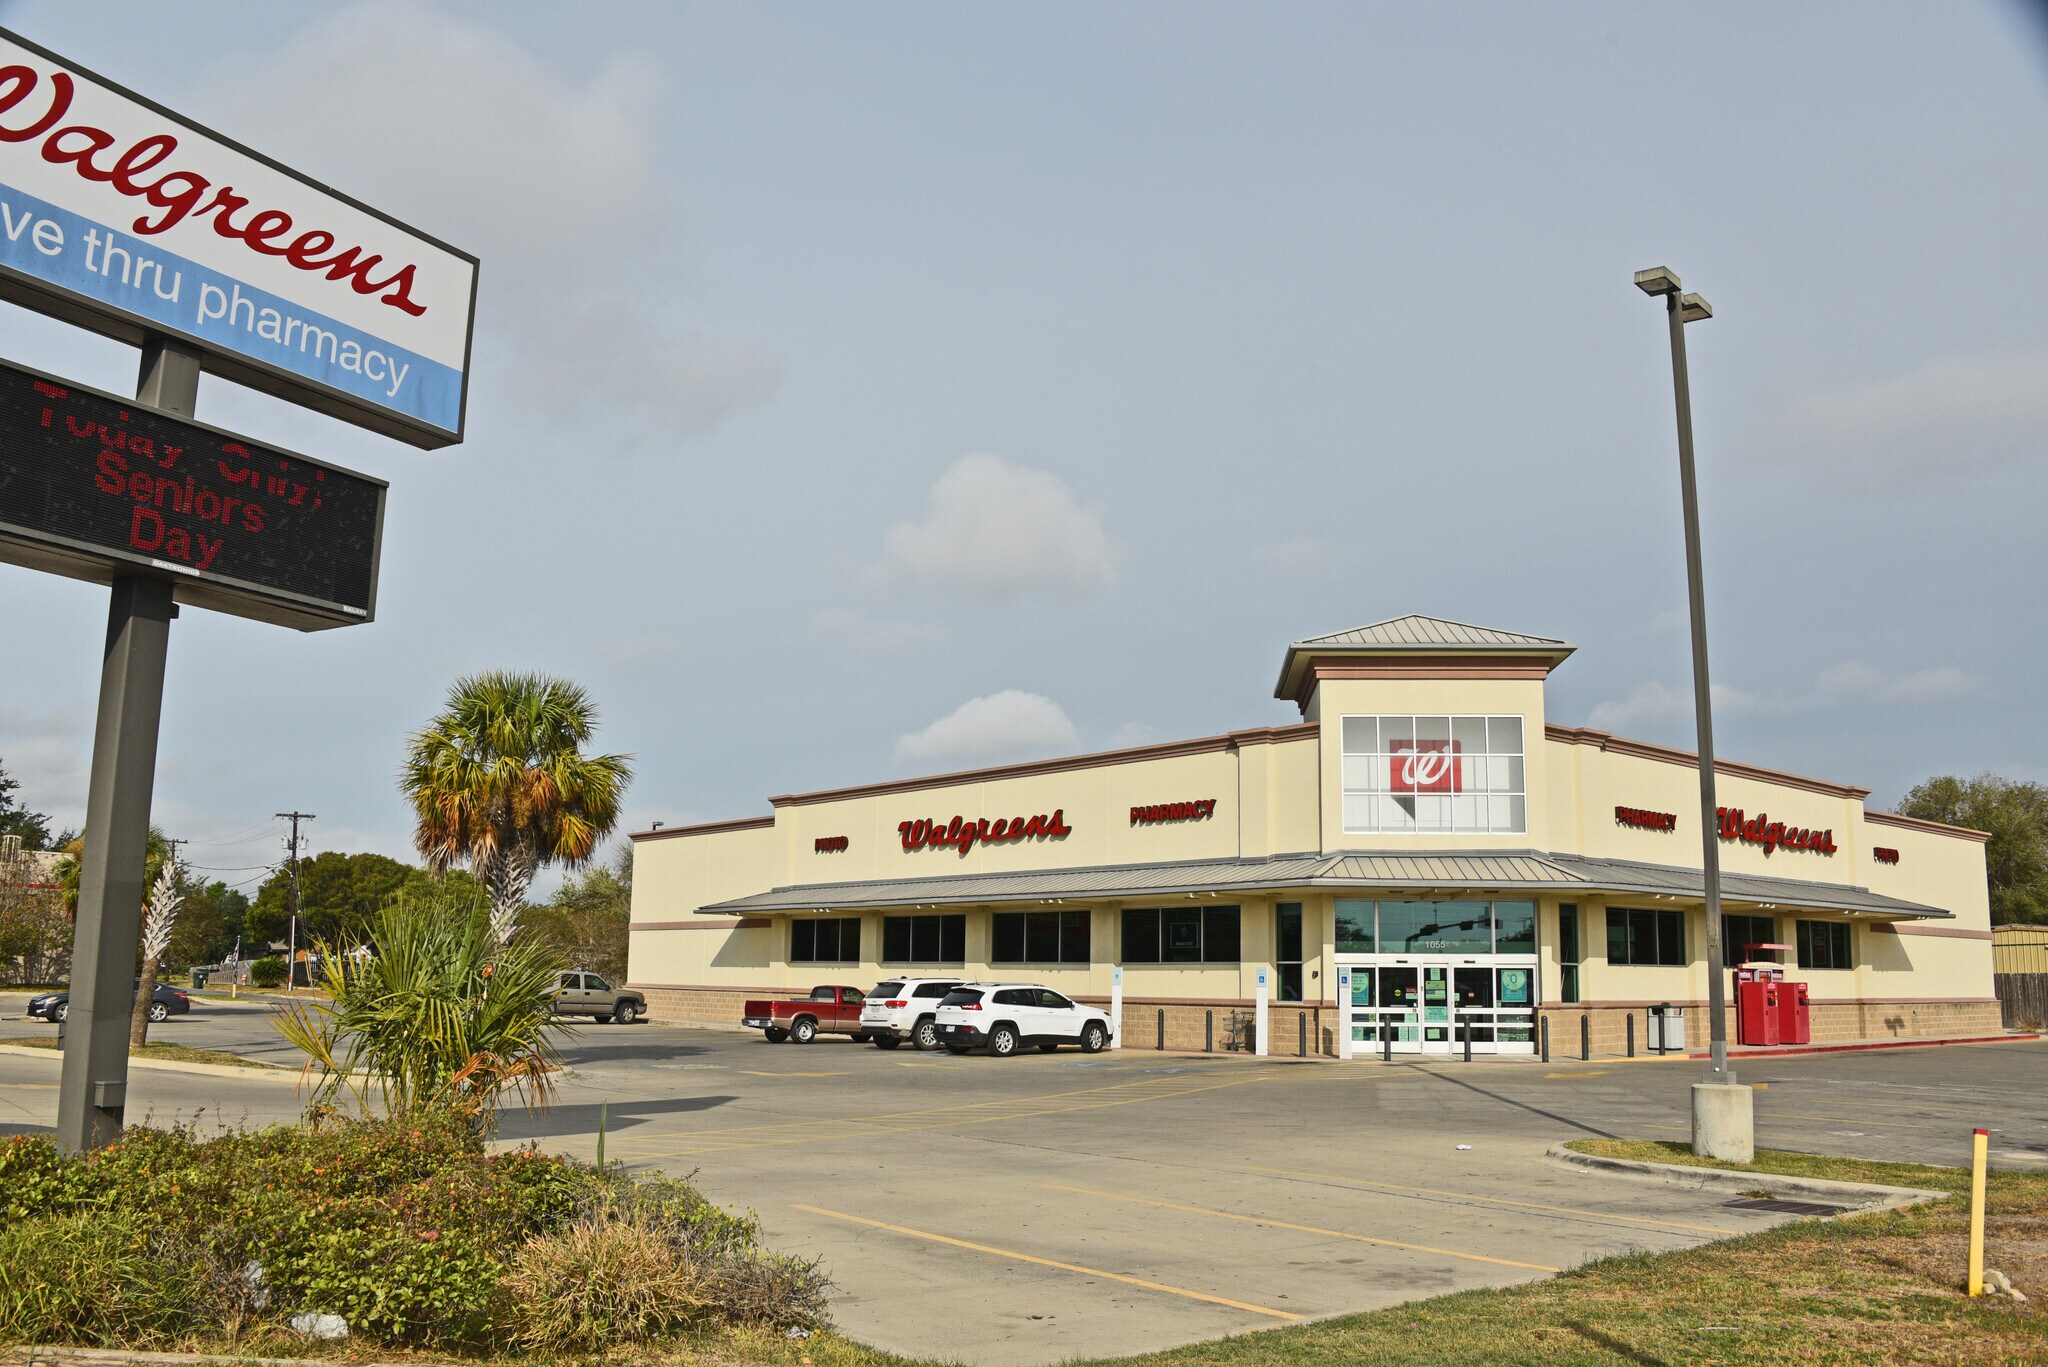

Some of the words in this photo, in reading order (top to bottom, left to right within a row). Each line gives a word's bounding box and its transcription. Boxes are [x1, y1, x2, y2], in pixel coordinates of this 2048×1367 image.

[83, 227, 182, 303] thru
[197, 282, 410, 397] pharmacy
[94, 450, 266, 534] Seniors
[129, 505, 225, 570] Day
[152, 559, 200, 576] DAKTRONICS
[1130, 799, 1217, 824] PHARMACY
[1616, 806, 1677, 831] PHARMACY
[814, 836, 849, 853] PHOTO
[898, 809, 1072, 854] Walgreens
[1715, 807, 1838, 854] Walgreens
[1425, 941, 1446, 949] 1055
